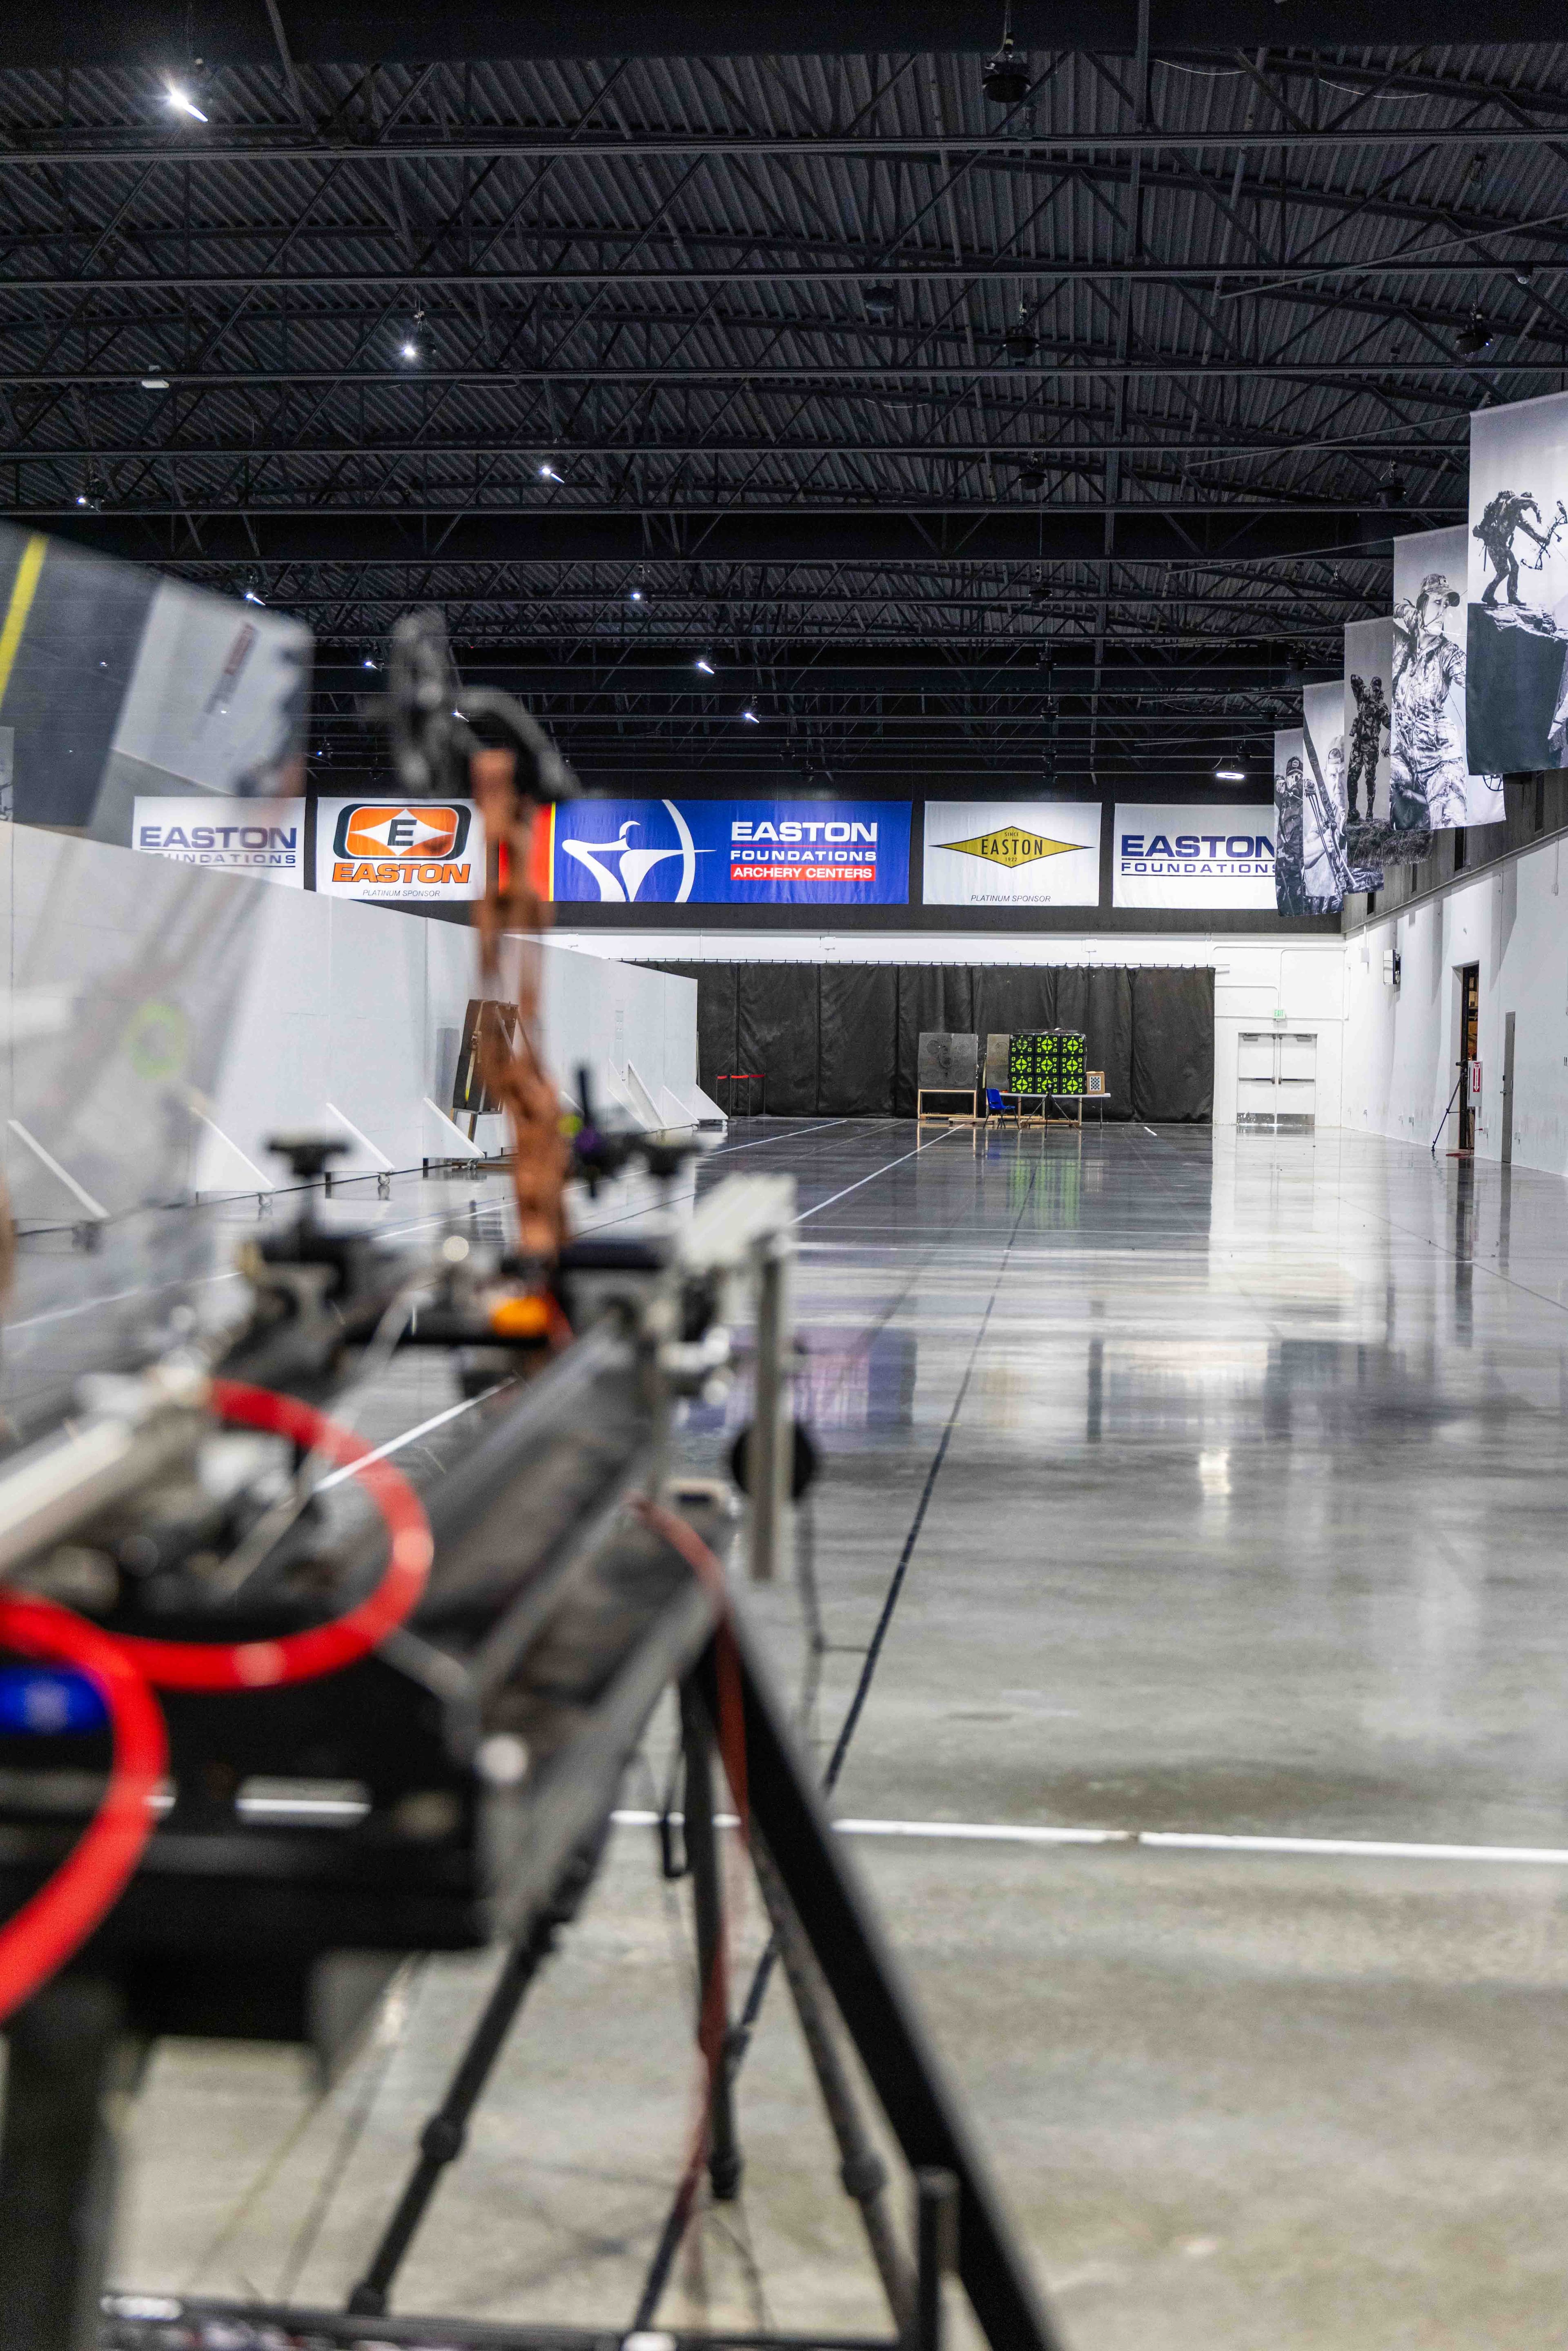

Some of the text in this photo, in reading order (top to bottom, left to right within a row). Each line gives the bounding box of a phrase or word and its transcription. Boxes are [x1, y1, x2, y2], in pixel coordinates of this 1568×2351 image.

[140, 826, 297, 849] EASTON
[387, 819, 417, 846] E
[731, 822, 878, 842] EASTON
[731, 850, 876, 861] FOUNDATIONS
[981, 839, 1043, 855] EASTON
[1121, 835, 1275, 858] EASTON
[155, 853, 296, 864] NDATIONS
[332, 862, 471, 883] EASTON
[733, 867, 872, 878] ARCHERY CENTERS
